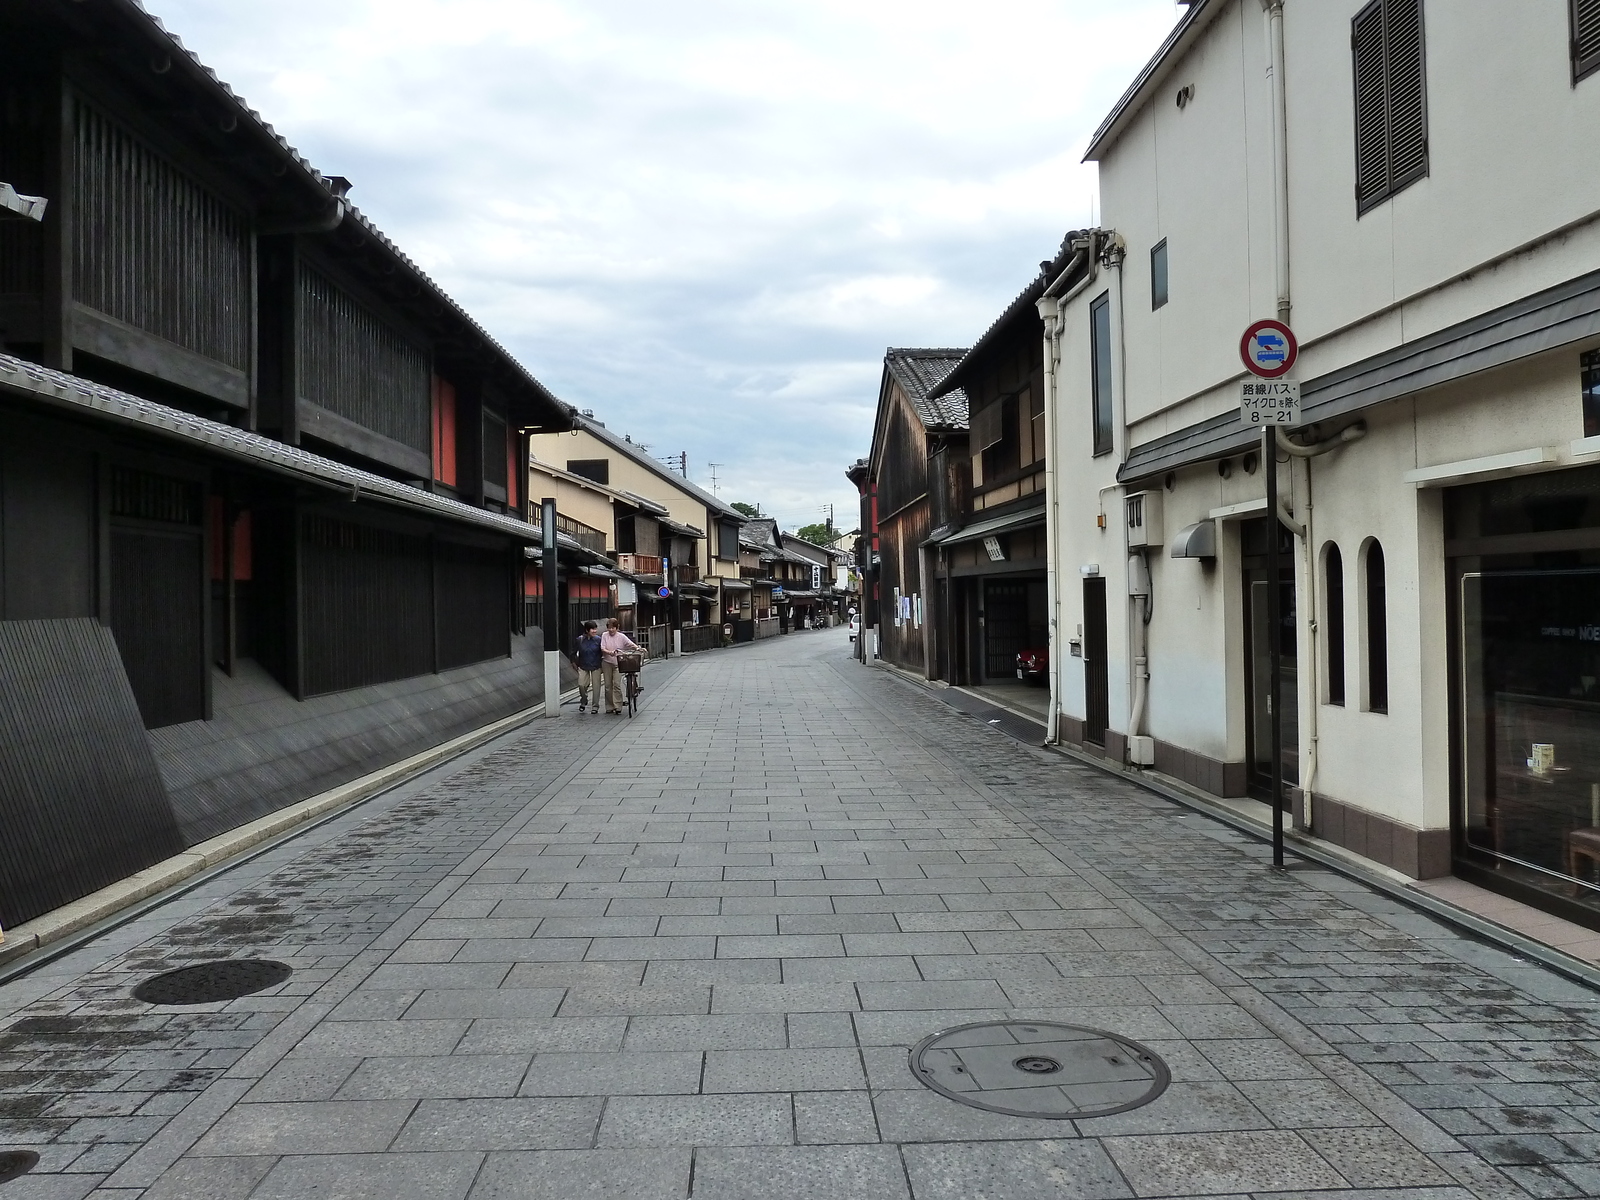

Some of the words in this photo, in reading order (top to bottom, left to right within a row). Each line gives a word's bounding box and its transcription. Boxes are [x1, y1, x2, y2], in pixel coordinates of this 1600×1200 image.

[1243, 397, 1299, 408] マイクロを除く
